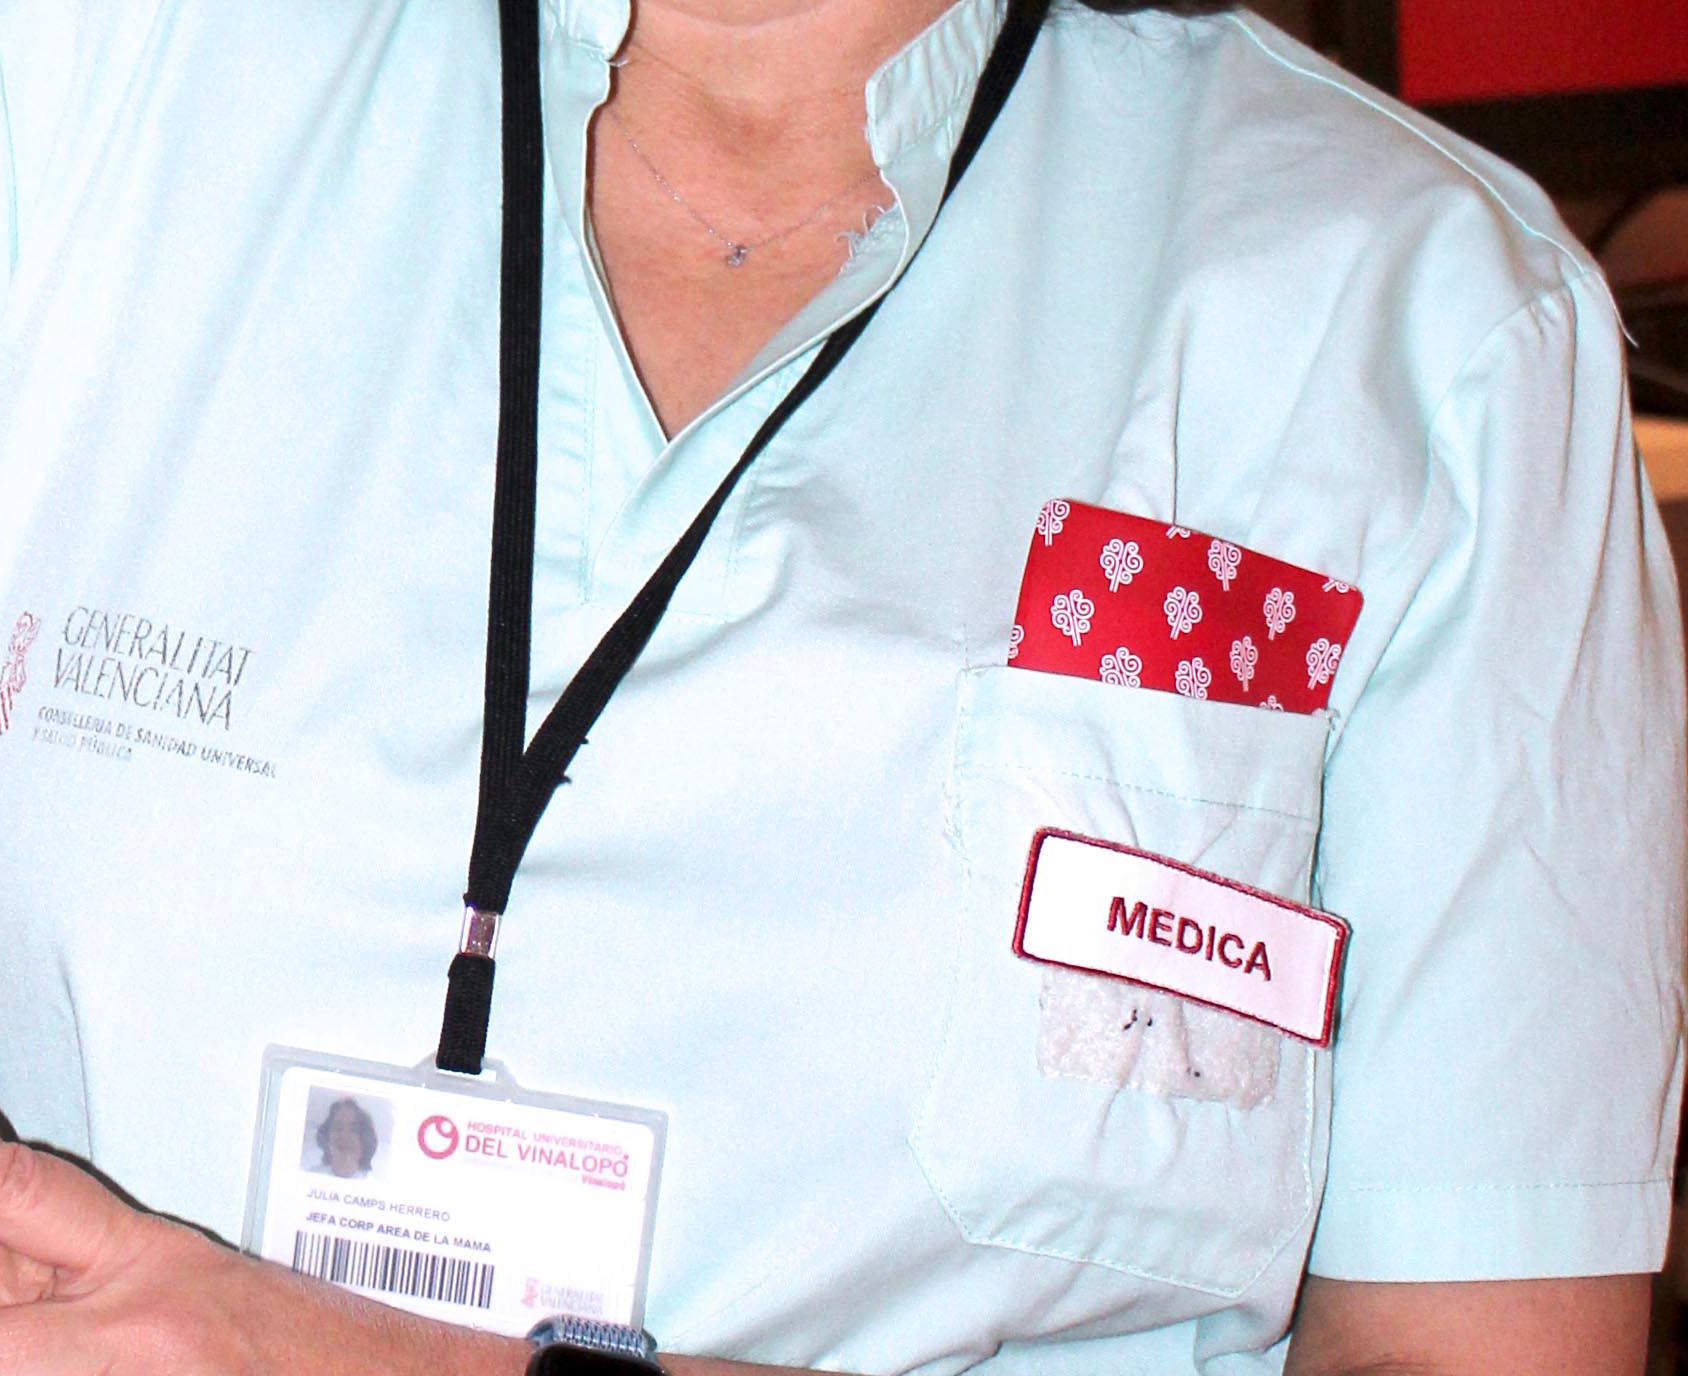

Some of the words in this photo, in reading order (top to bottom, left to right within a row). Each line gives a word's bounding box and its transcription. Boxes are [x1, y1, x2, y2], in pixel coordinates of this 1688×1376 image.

[62, 605, 255, 688] GENERALITAT
[53, 647, 234, 731] VALENCIANA
[135, 727, 197, 757] SANIDAD
[1107, 896, 1272, 982] MEDICA
[465, 1134, 508, 1158] DEL
[467, 1121, 526, 1140] HOSPITAL
[534, 1132, 622, 1154] UNIVERSITARIO
[307, 1189, 340, 1202] JULIA
[344, 1194, 386, 1211] CAMPS
[390, 1203, 450, 1222] HERRERO
[306, 1212, 336, 1226] JEFA
[339, 1217, 374, 1231] CORP
[377, 1224, 410, 1239] AREA
[414, 1230, 430, 1242] DE
[434, 1234, 449, 1246] LA
[453, 1237, 491, 1252] MAMA
